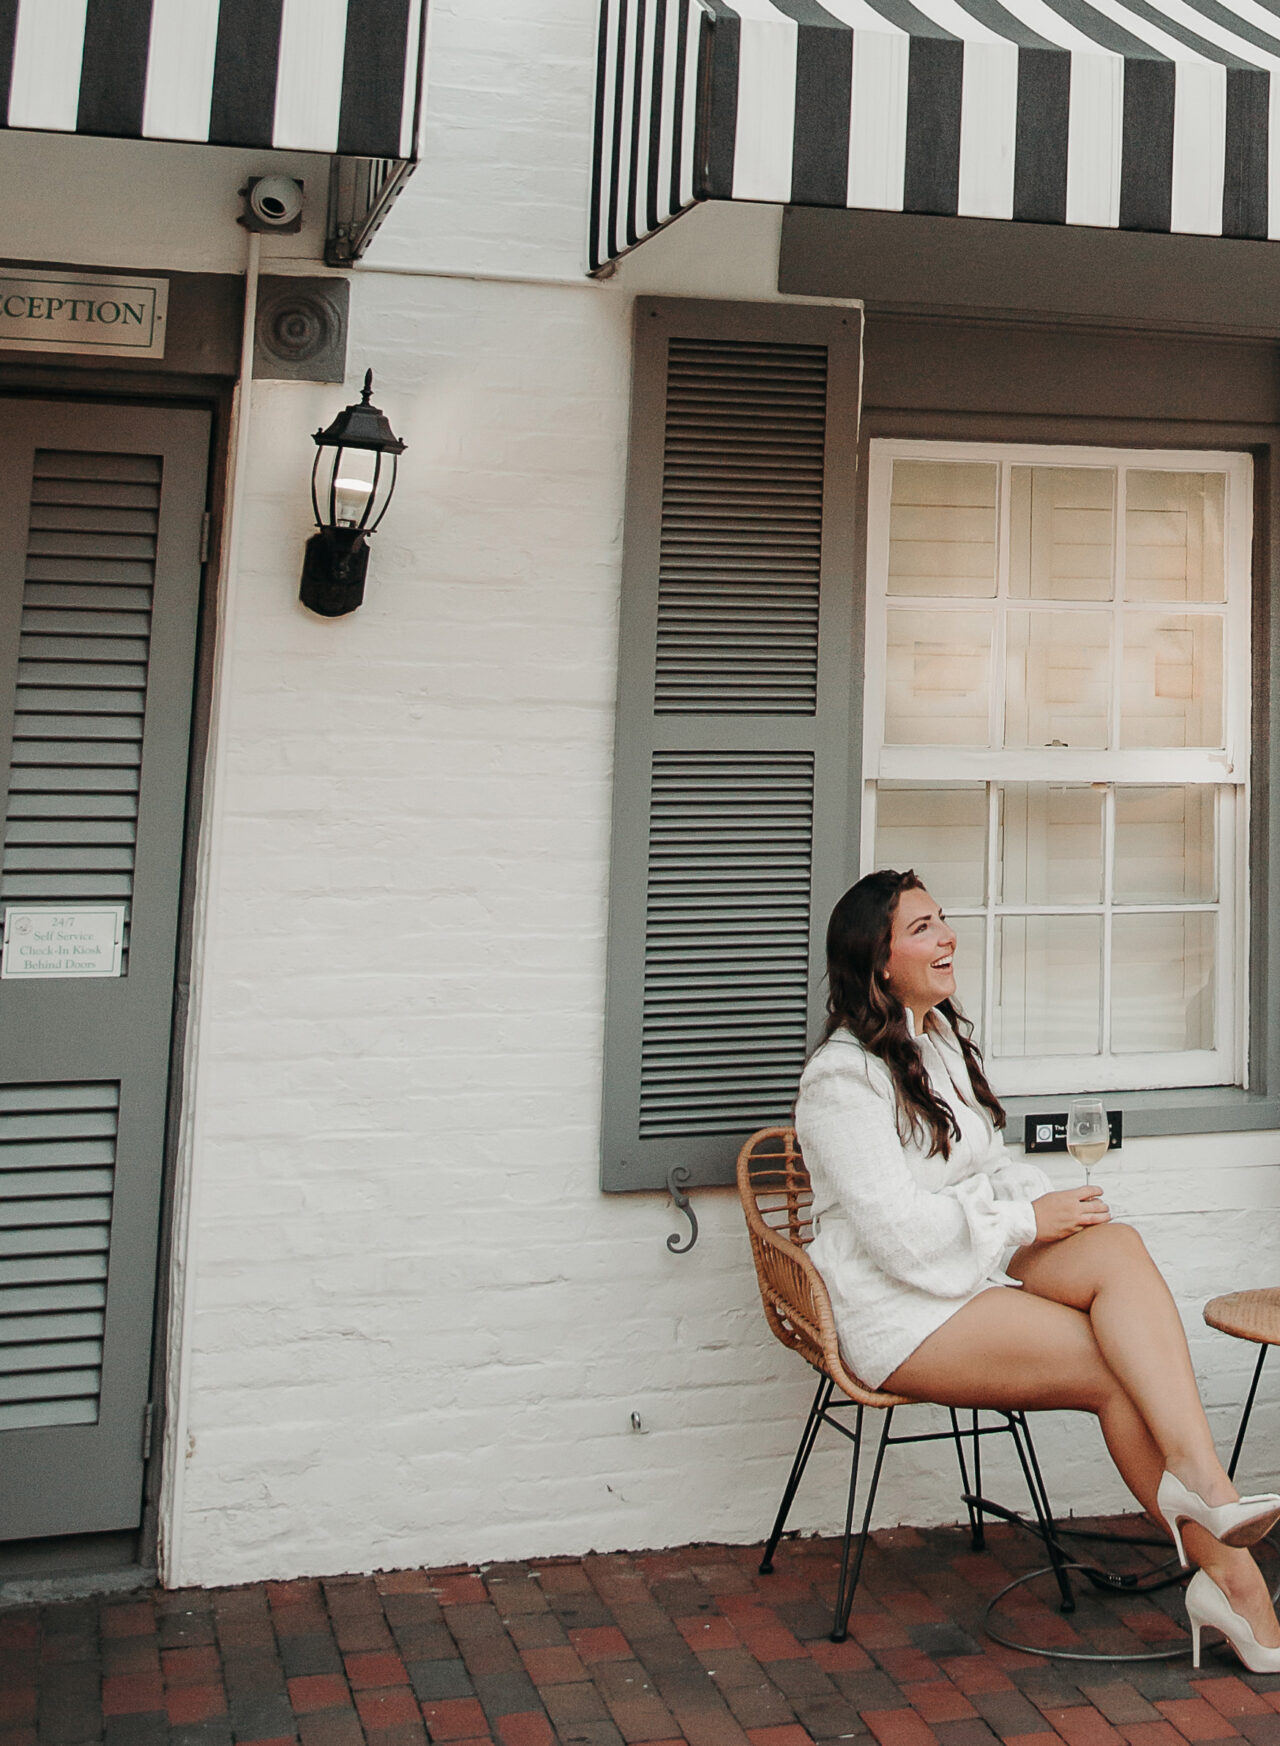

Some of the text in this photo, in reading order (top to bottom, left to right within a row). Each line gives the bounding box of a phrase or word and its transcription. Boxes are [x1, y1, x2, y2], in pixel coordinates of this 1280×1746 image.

[0, 294, 145, 325] CEPTION
[34, 931, 94, 941] Self Service
[20, 945, 102, 956] Check-In Kiosk
[24, 960, 96, 969] Behind Doors
